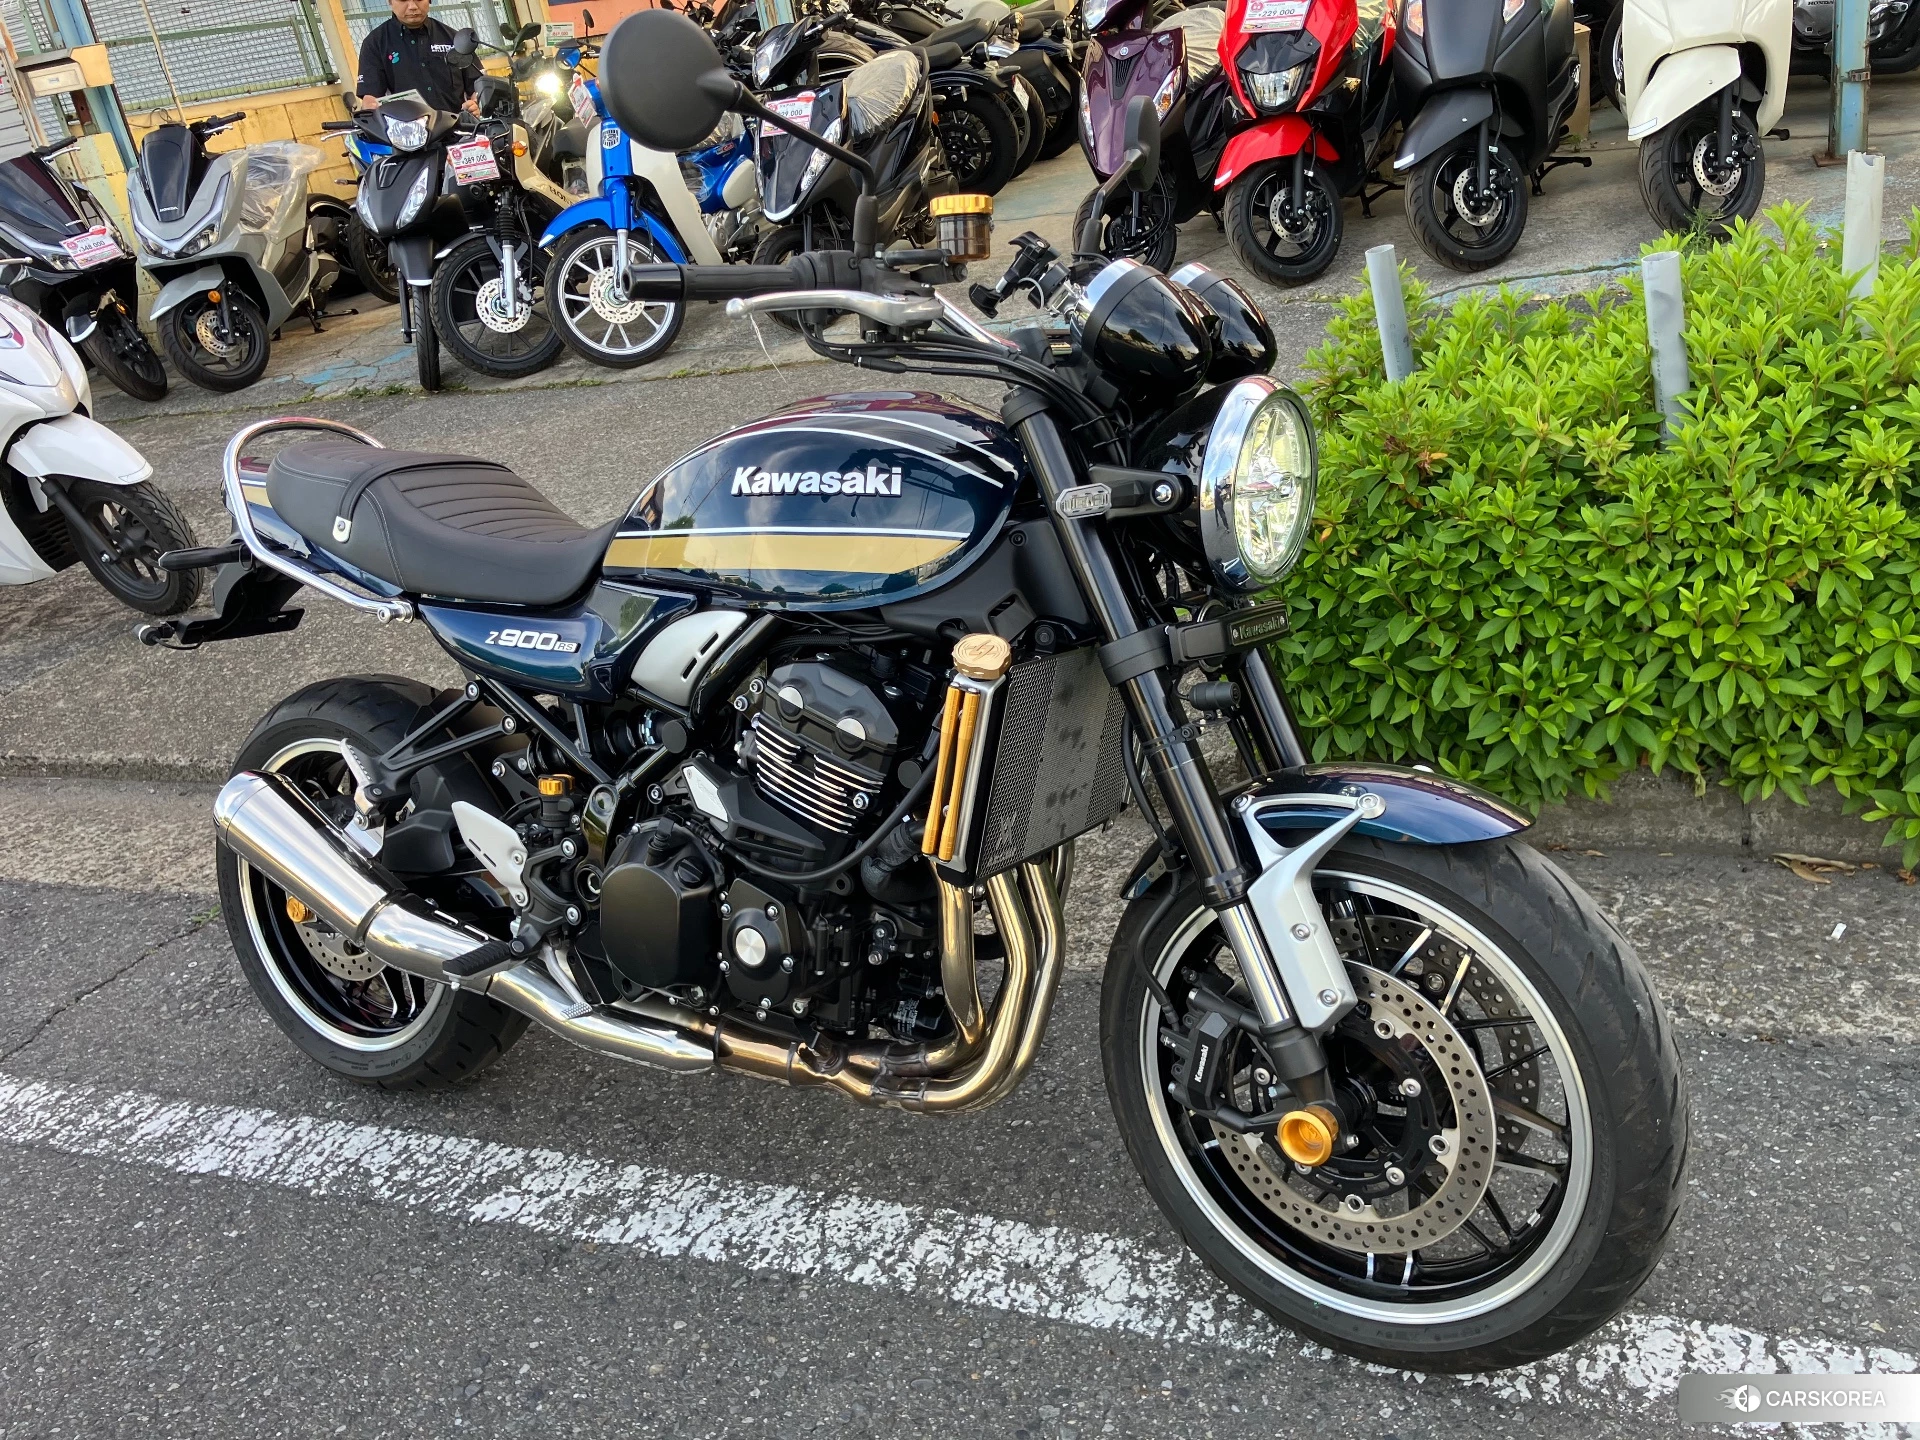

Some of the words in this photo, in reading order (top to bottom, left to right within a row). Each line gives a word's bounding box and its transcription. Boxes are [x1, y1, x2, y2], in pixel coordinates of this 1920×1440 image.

[730, 466, 903, 497] Kawasaki
[1239, 615, 1280, 639] Kawasaki
[1194, 1043, 1209, 1083] Kawasaki
